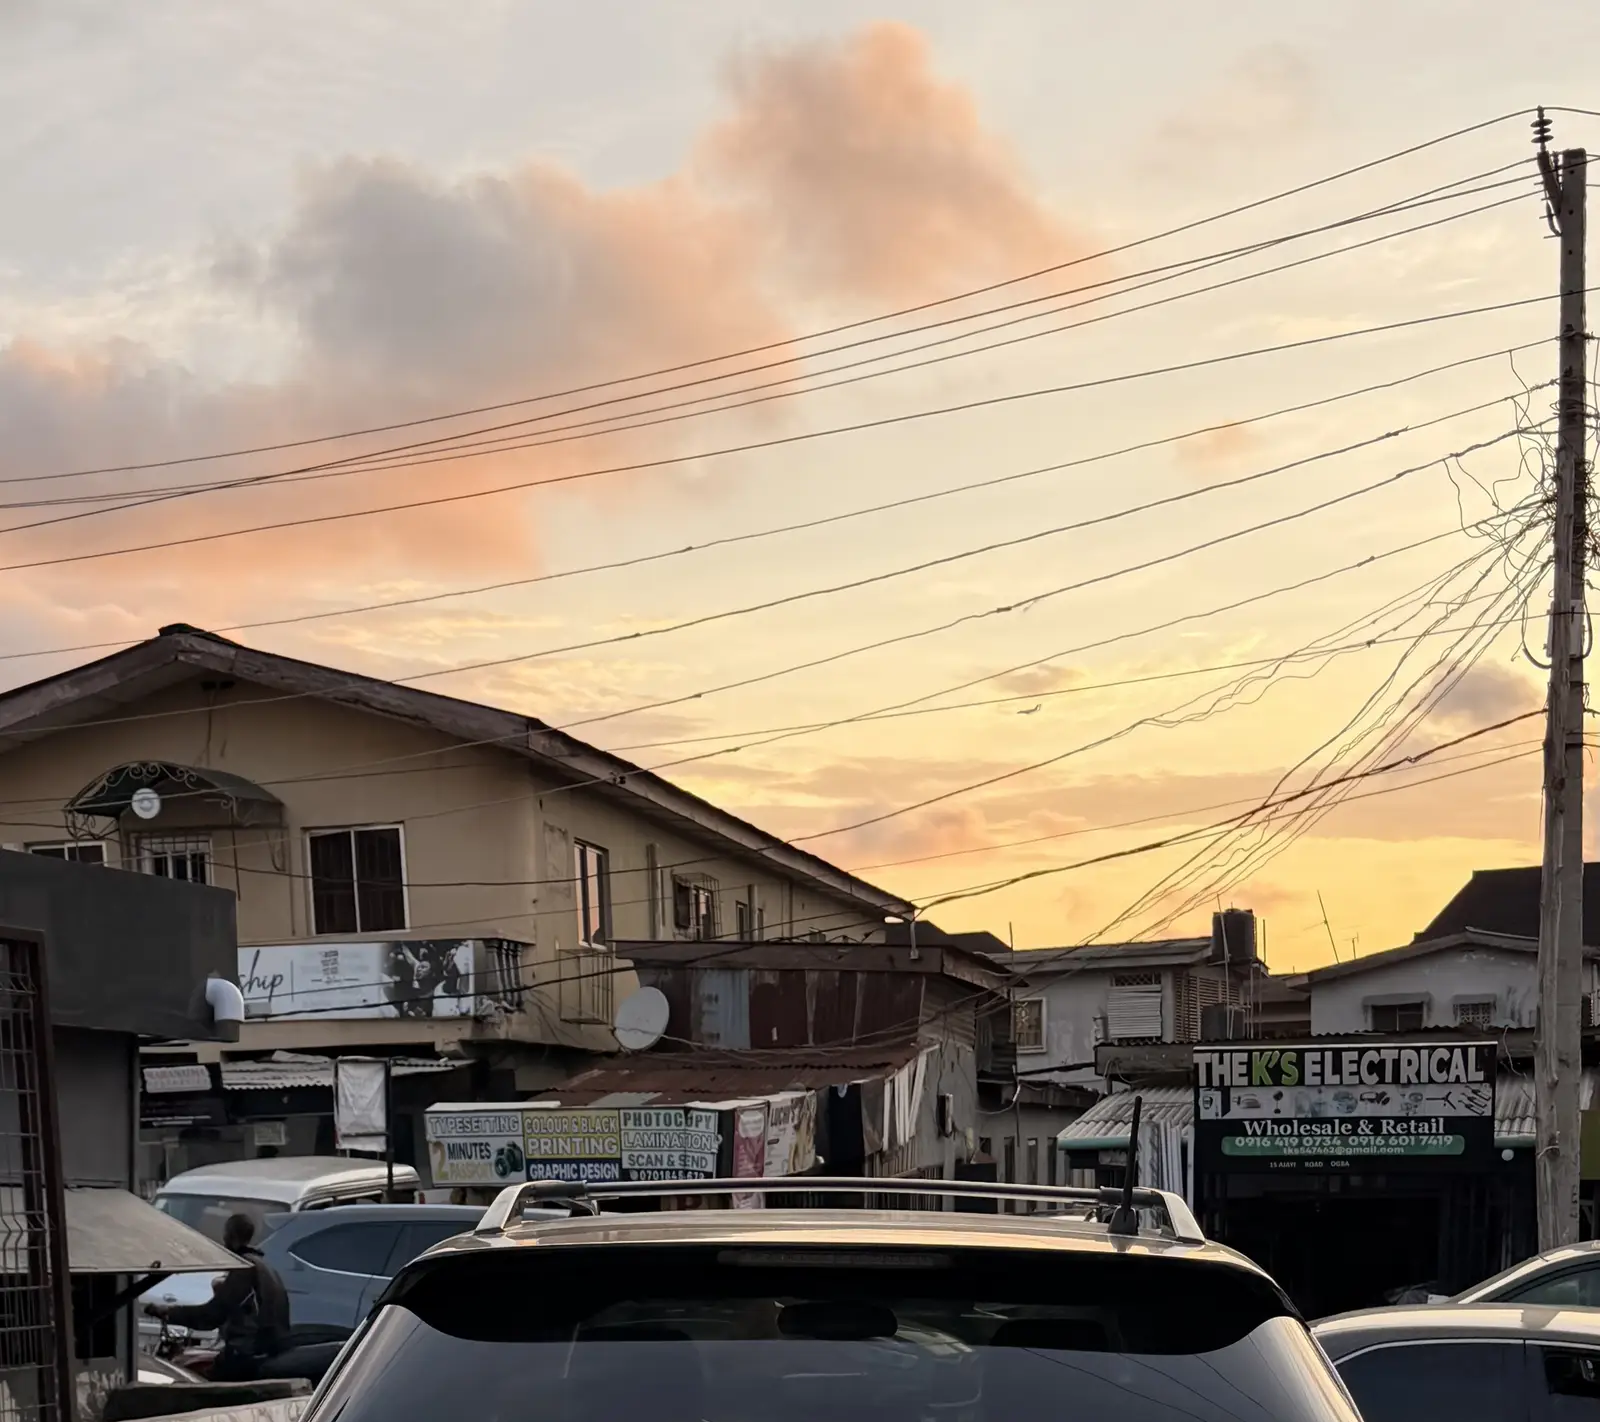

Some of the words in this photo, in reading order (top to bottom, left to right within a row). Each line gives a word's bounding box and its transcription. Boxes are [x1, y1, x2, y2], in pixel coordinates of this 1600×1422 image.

[1193, 1052, 1248, 1087] THE
[1252, 1051, 1299, 1087] K'S
[1304, 1047, 1484, 1086] ELECTRICAL
[428, 1115, 520, 1134] TYPESETTING
[524, 1115, 569, 1135] COLOUR
[571, 1116, 578, 1134] &
[581, 1115, 618, 1134] BLACK
[622, 1111, 712, 1130] PHOTOCOPY
[1243, 1119, 1353, 1136] Wholesale
[1357, 1118, 1374, 1135] &
[1381, 1117, 1445, 1135] Retail
[527, 1135, 618, 1156] PRINTING
[622, 1131, 713, 1151] LAMINATION
[1235, 1136, 1271, 1147] 0916
[1274, 1136, 1299, 1147] 419
[1303, 1136, 1342, 1147] 0734
[1348, 1136, 1385, 1147] 0916
[1388, 1135, 1416, 1147] 601
[1420, 1135, 1454, 1146] 7419
[433, 1140, 449, 1180] 2
[447, 1141, 492, 1161] MINUTES
[529, 1162, 583, 1180] GRAPHIC
[584, 1161, 620, 1180] DESIGN
[627, 1153, 664, 1168] SCAN
[666, 1153, 677, 1168] &
[678, 1154, 708, 1169] SEND
